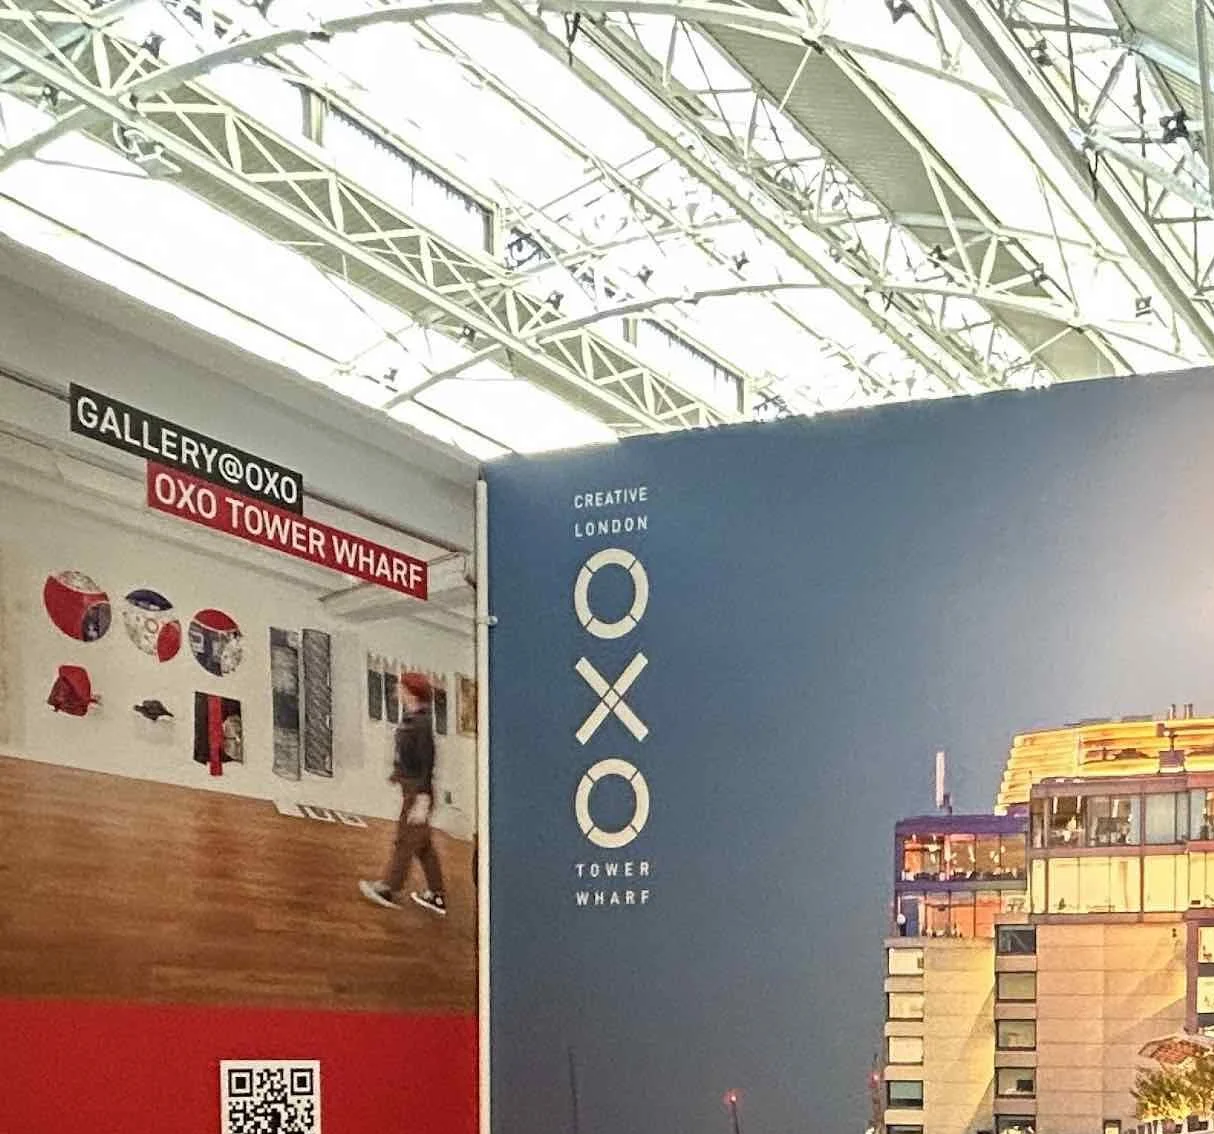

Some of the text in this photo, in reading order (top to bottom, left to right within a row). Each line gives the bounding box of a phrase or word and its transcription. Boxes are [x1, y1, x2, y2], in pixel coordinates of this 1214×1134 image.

[75, 396, 298, 505] GALLERY@OXO
[573, 486, 649, 509] CREATIVE
[154, 472, 425, 592] OXO TOWER WHARF
[574, 515, 649, 538] LONDON
[575, 860, 650, 878] TOWER
[575, 889, 650, 906] WHARF
